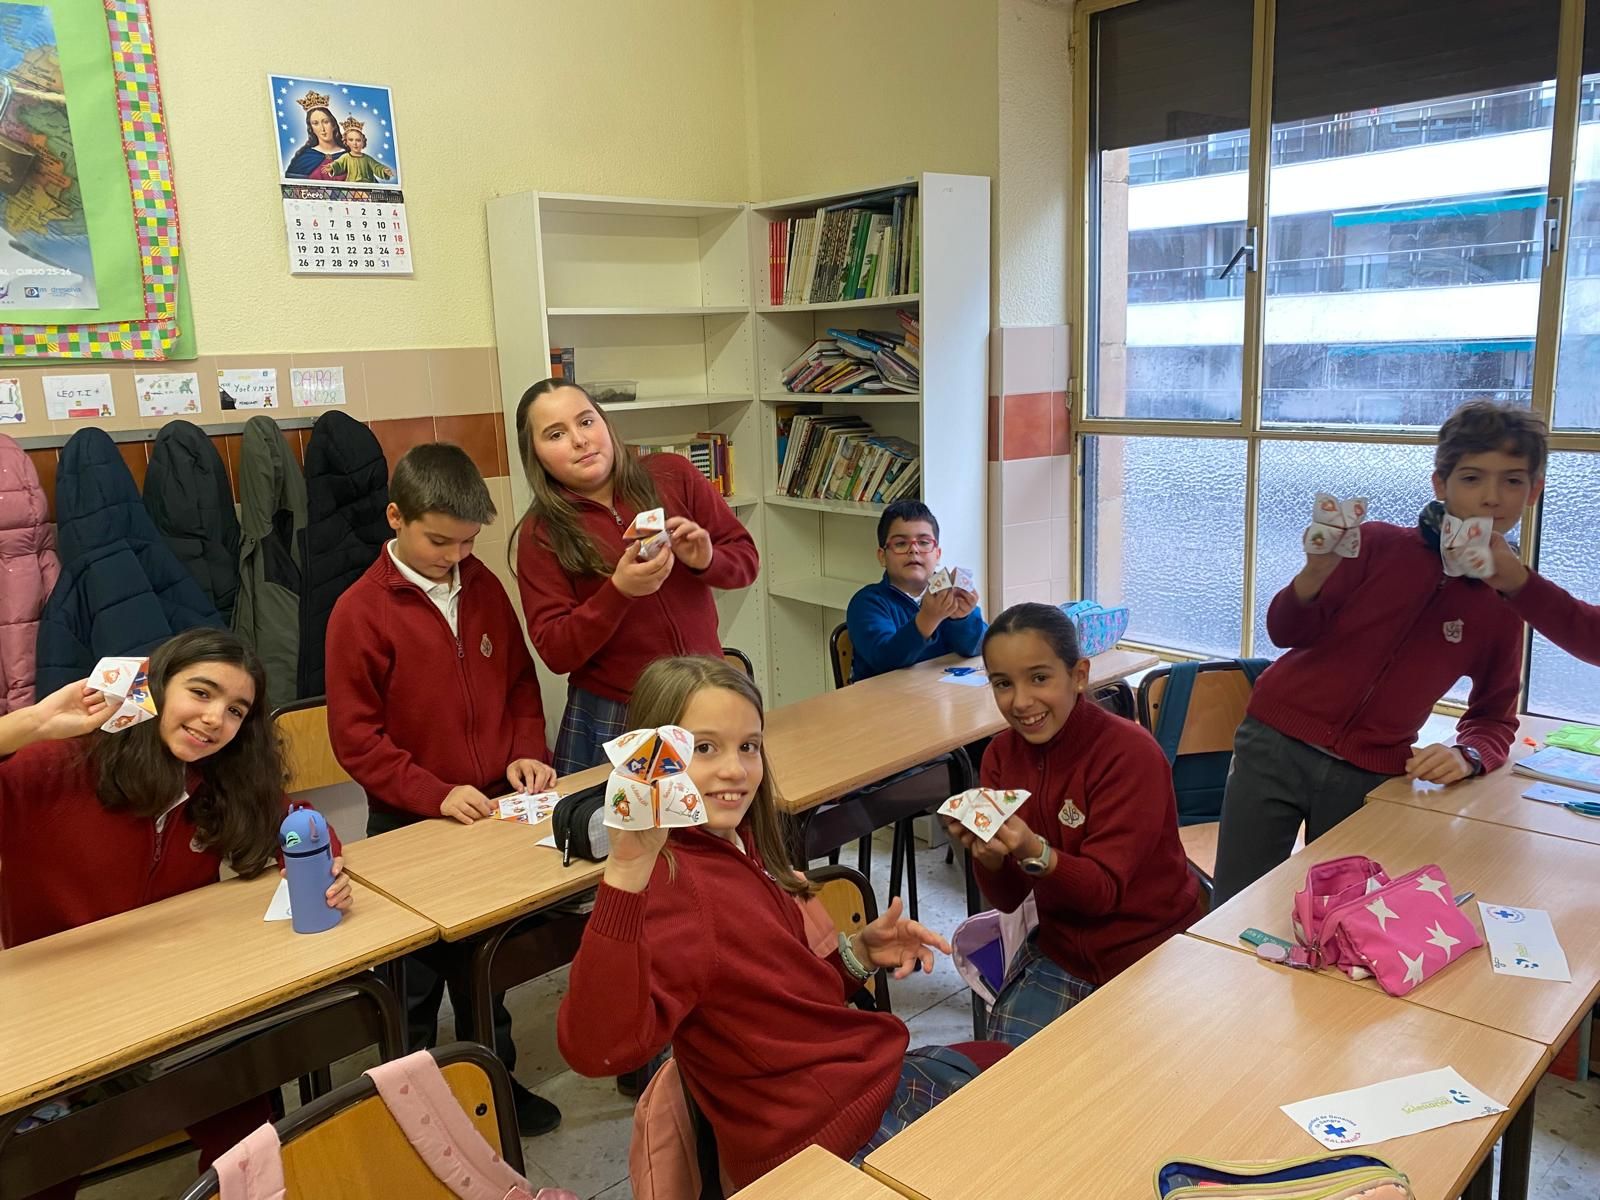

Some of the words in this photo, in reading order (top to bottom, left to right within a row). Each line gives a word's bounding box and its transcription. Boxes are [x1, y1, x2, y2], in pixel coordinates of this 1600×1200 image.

[345, 207, 350, 215] 1
[361, 207, 367, 216] 2
[377, 208, 382, 217] 3
[392, 209, 398, 217] 4
[295, 218, 302, 227] 5
[312, 218, 319, 228] 6
[329, 219, 335, 228] 7
[346, 220, 352, 228] 8
[362, 220, 368, 229] 9
[377, 221, 386, 230] 10
[392, 221, 401, 230] 11
[295, 231, 305, 241] 12
[312, 232, 322, 241] 13
[329, 232, 340, 241] 14
[346, 233, 356, 242] 15
[362, 233, 372, 242] 16
[378, 234, 387, 242] 17
[393, 234, 404, 243] 18
[297, 245, 307, 254] 19
[313, 245, 325, 254] 20
[330, 246, 340, 255] 21
[346, 246, 358, 255] 22
[362, 246, 374, 255] 23
[379, 247, 390, 256] 24
[395, 247, 406, 256] 25
[298, 258, 309, 267] 26
[315, 258, 325, 267] 27
[331, 259, 343, 268] 28
[348, 259, 359, 268] 29
[364, 259, 376, 268] 30
[381, 260, 390, 268] 31
